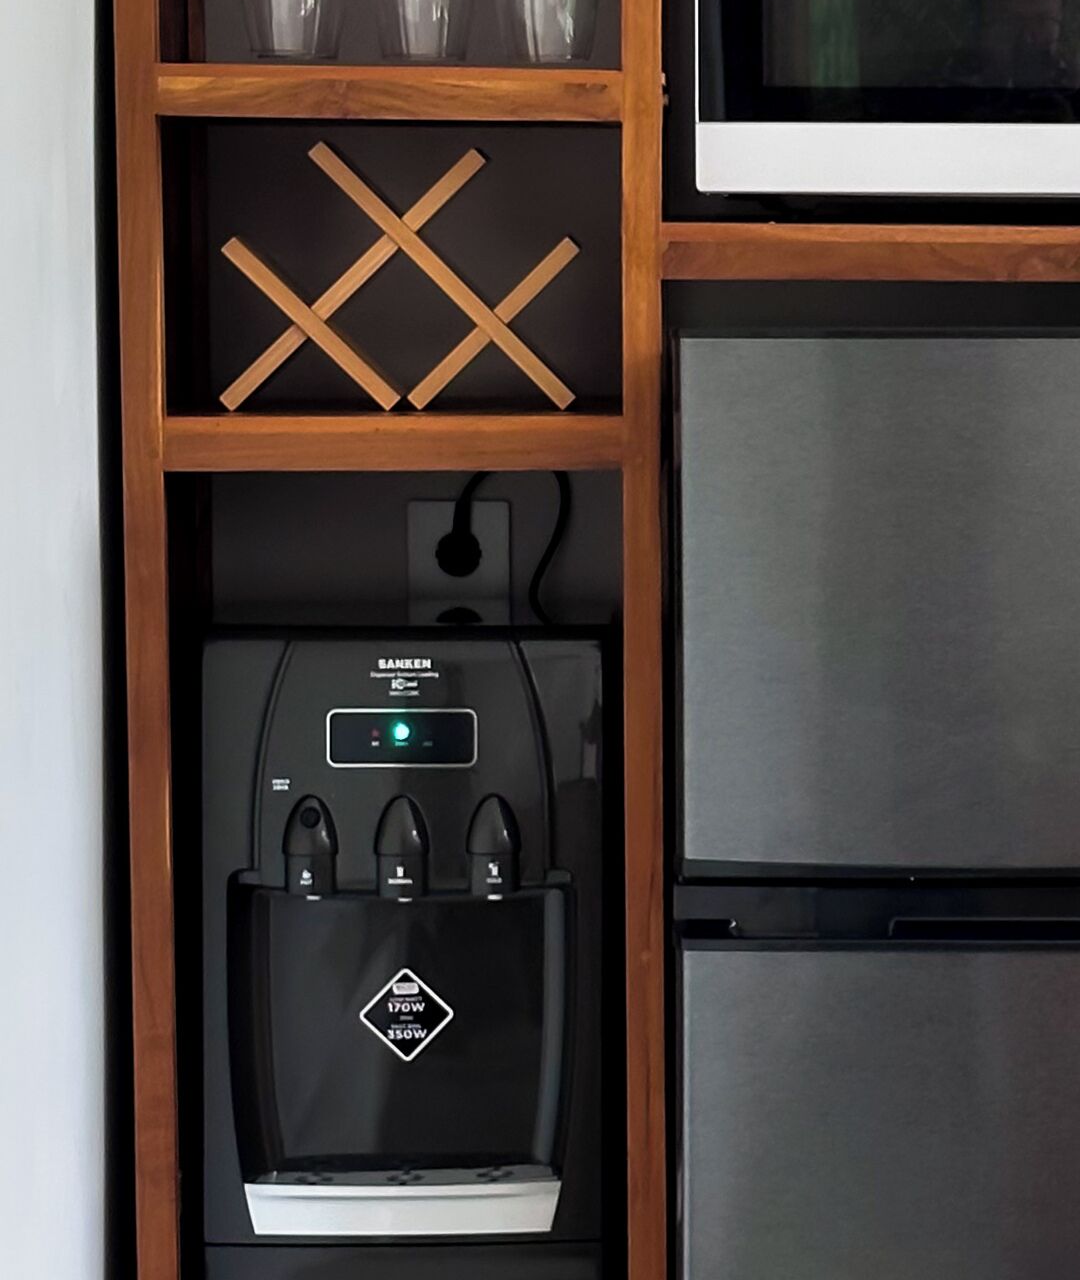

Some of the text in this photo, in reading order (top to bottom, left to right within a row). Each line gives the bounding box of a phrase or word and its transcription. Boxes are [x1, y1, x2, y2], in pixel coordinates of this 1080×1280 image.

[378, 658, 432, 669] SANKEN
[387, 1002, 425, 1013] 170W
[387, 1029, 427, 1040] 350W
